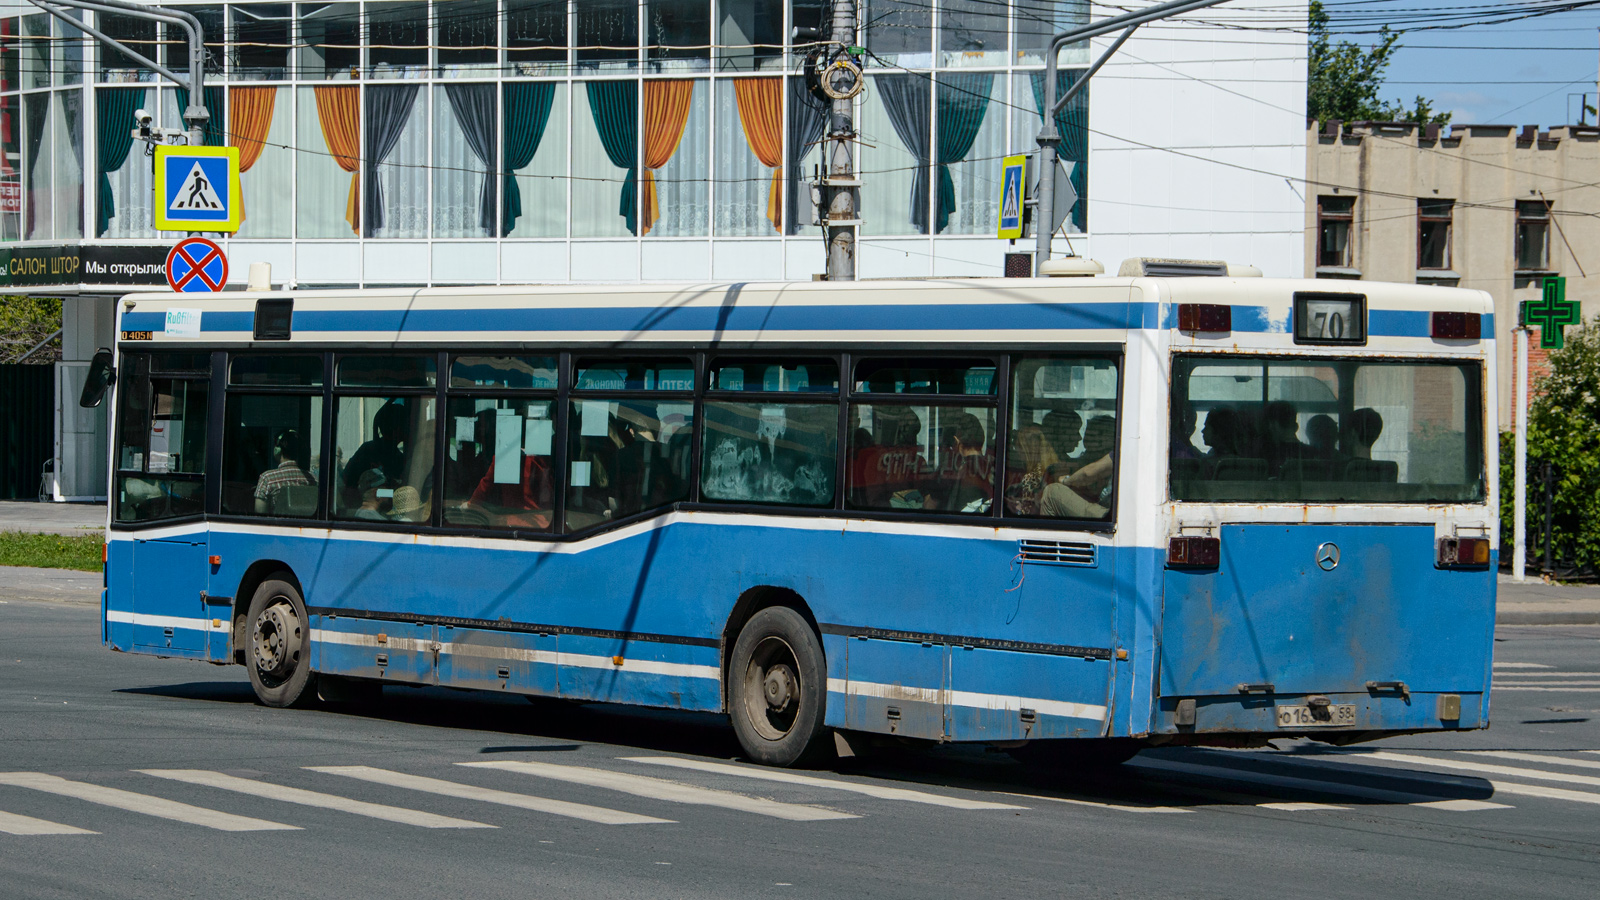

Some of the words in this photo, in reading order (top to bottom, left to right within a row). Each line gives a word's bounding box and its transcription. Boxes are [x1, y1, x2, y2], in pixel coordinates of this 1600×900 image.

[9, 257, 47, 276] САЛОН
[51, 255, 80, 275] ШТОР
[85, 260, 107, 274] Мы
[1314, 311, 1344, 339] 70
[129, 331, 146, 340] 405
